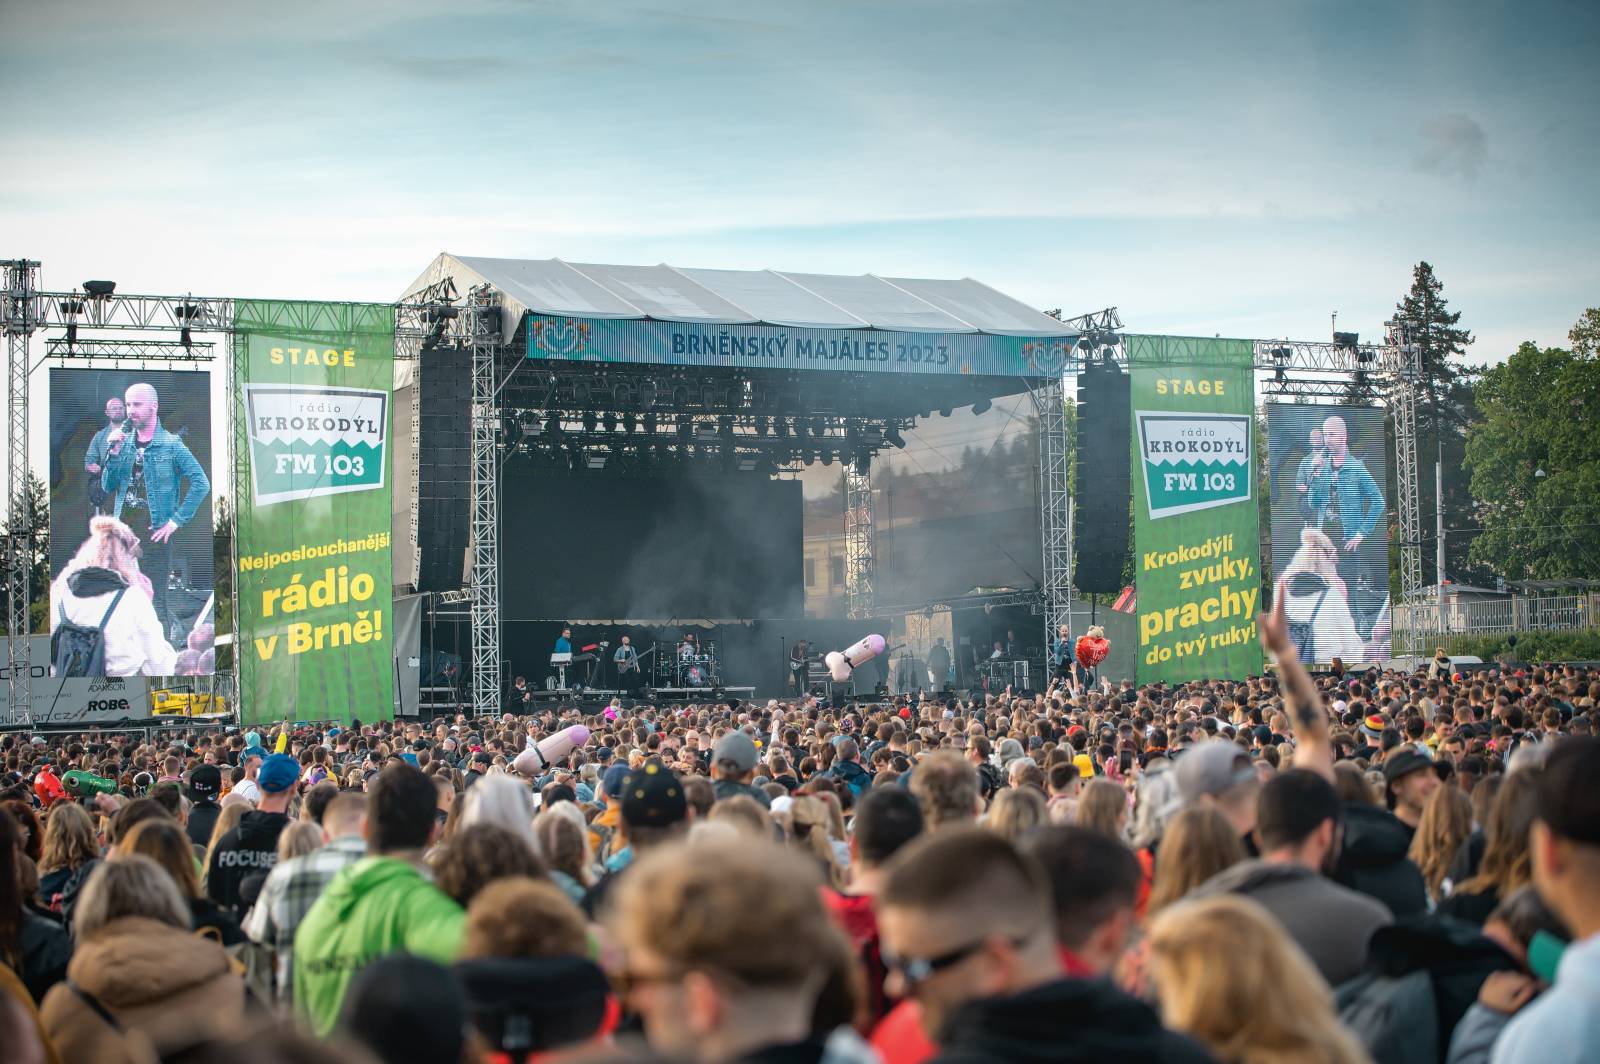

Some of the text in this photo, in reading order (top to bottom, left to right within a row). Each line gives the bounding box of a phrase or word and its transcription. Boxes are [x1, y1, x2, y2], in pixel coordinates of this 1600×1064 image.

[270, 348, 356, 367] STAGE
[672, 332, 949, 365] BRNĚNSKÝ MAJÁLES 2023
[1156, 379, 1225, 395] STAGE
[300, 402, 341, 413] rádio
[259, 416, 377, 434] KROKODÝL
[1181, 427, 1215, 437] rádio
[1150, 437, 1244, 453] KROKODÝL
[275, 454, 365, 477] FM 103
[1163, 473, 1235, 491] FM 103
[1144, 534, 1233, 571] Krokodýlí
[1180, 556, 1254, 589] zvuky,
[262, 565, 375, 617] rádio
[1141, 585, 1258, 646] prachy
[255, 610, 382, 661] v Brně!
[1146, 621, 1256, 665] do tvý ruky!
